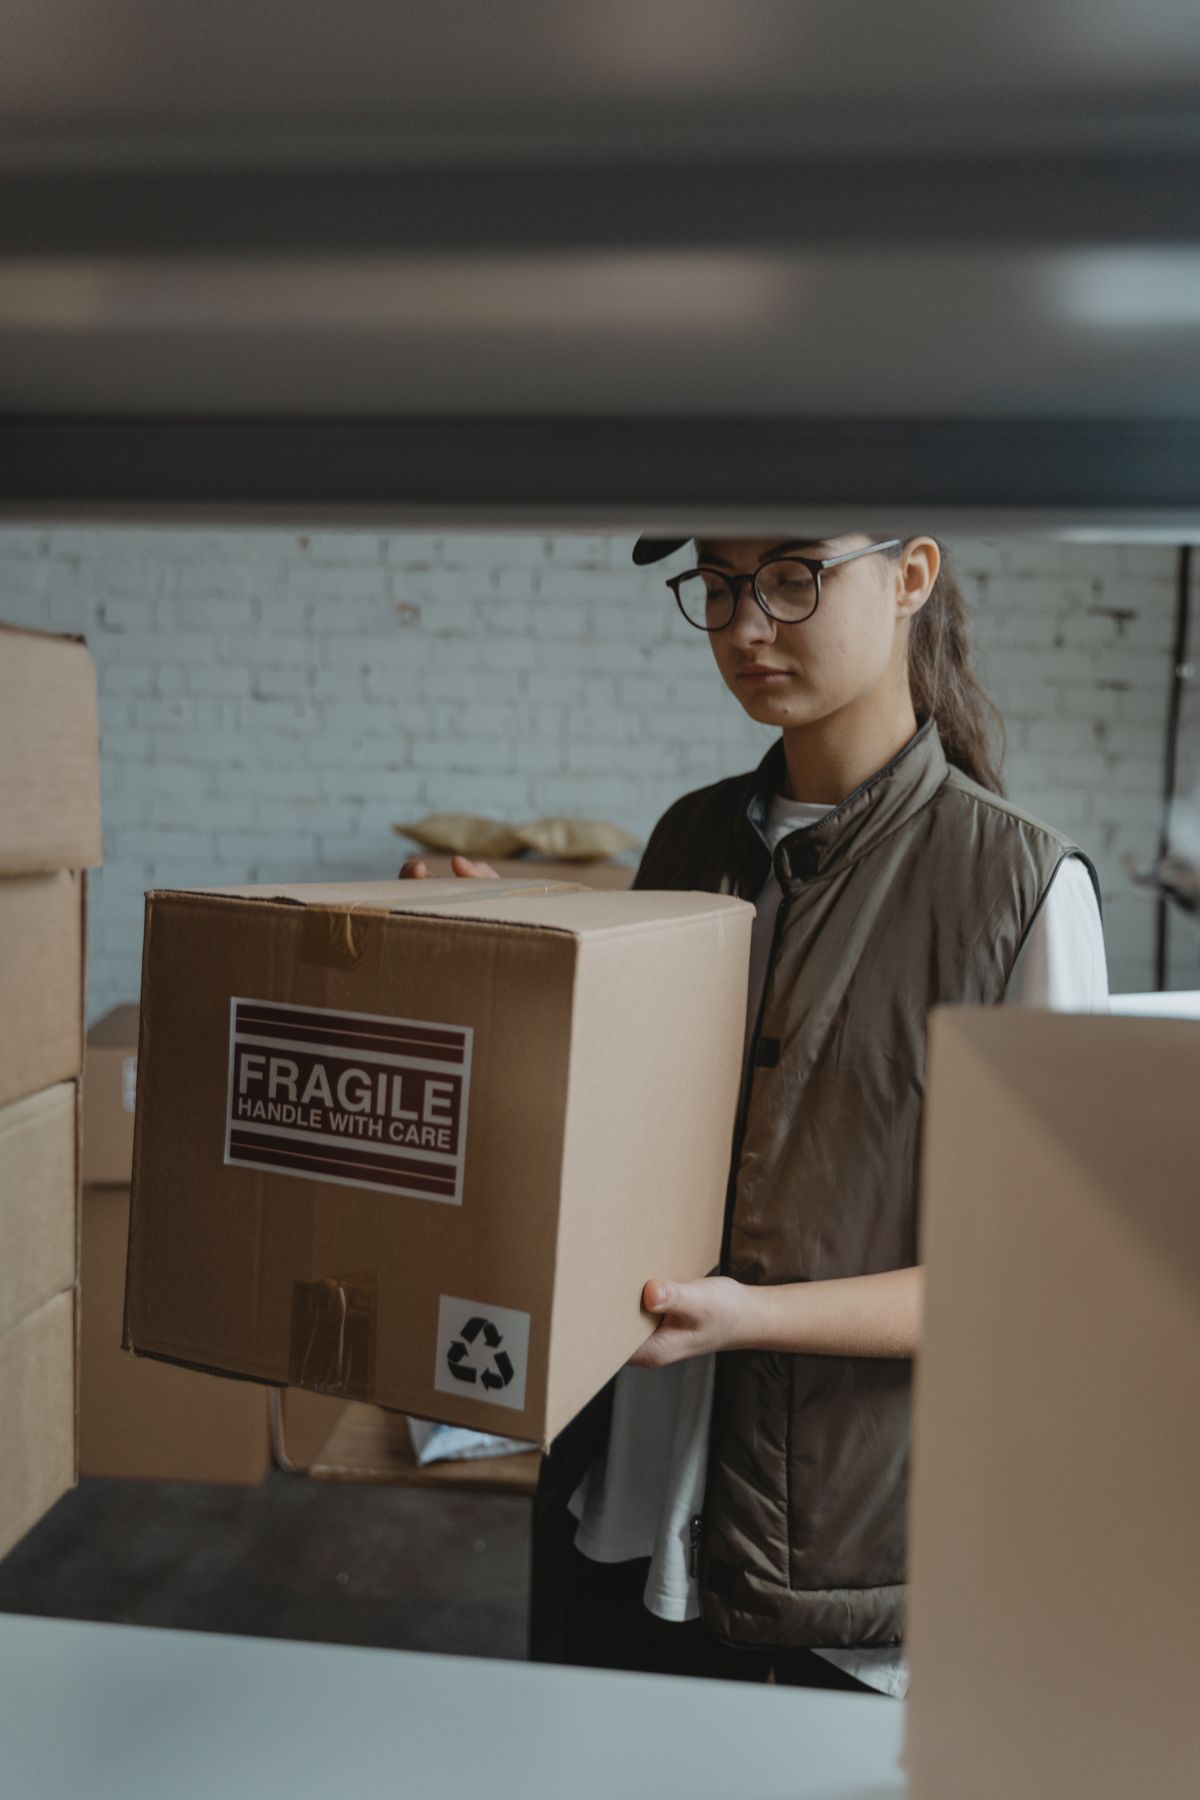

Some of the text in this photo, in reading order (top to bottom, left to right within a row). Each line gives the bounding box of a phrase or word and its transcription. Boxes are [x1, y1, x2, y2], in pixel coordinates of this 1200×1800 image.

[238, 1052, 455, 1126] FRAGILE
[238, 1097, 451, 1149] HANDLE WITH CARE
